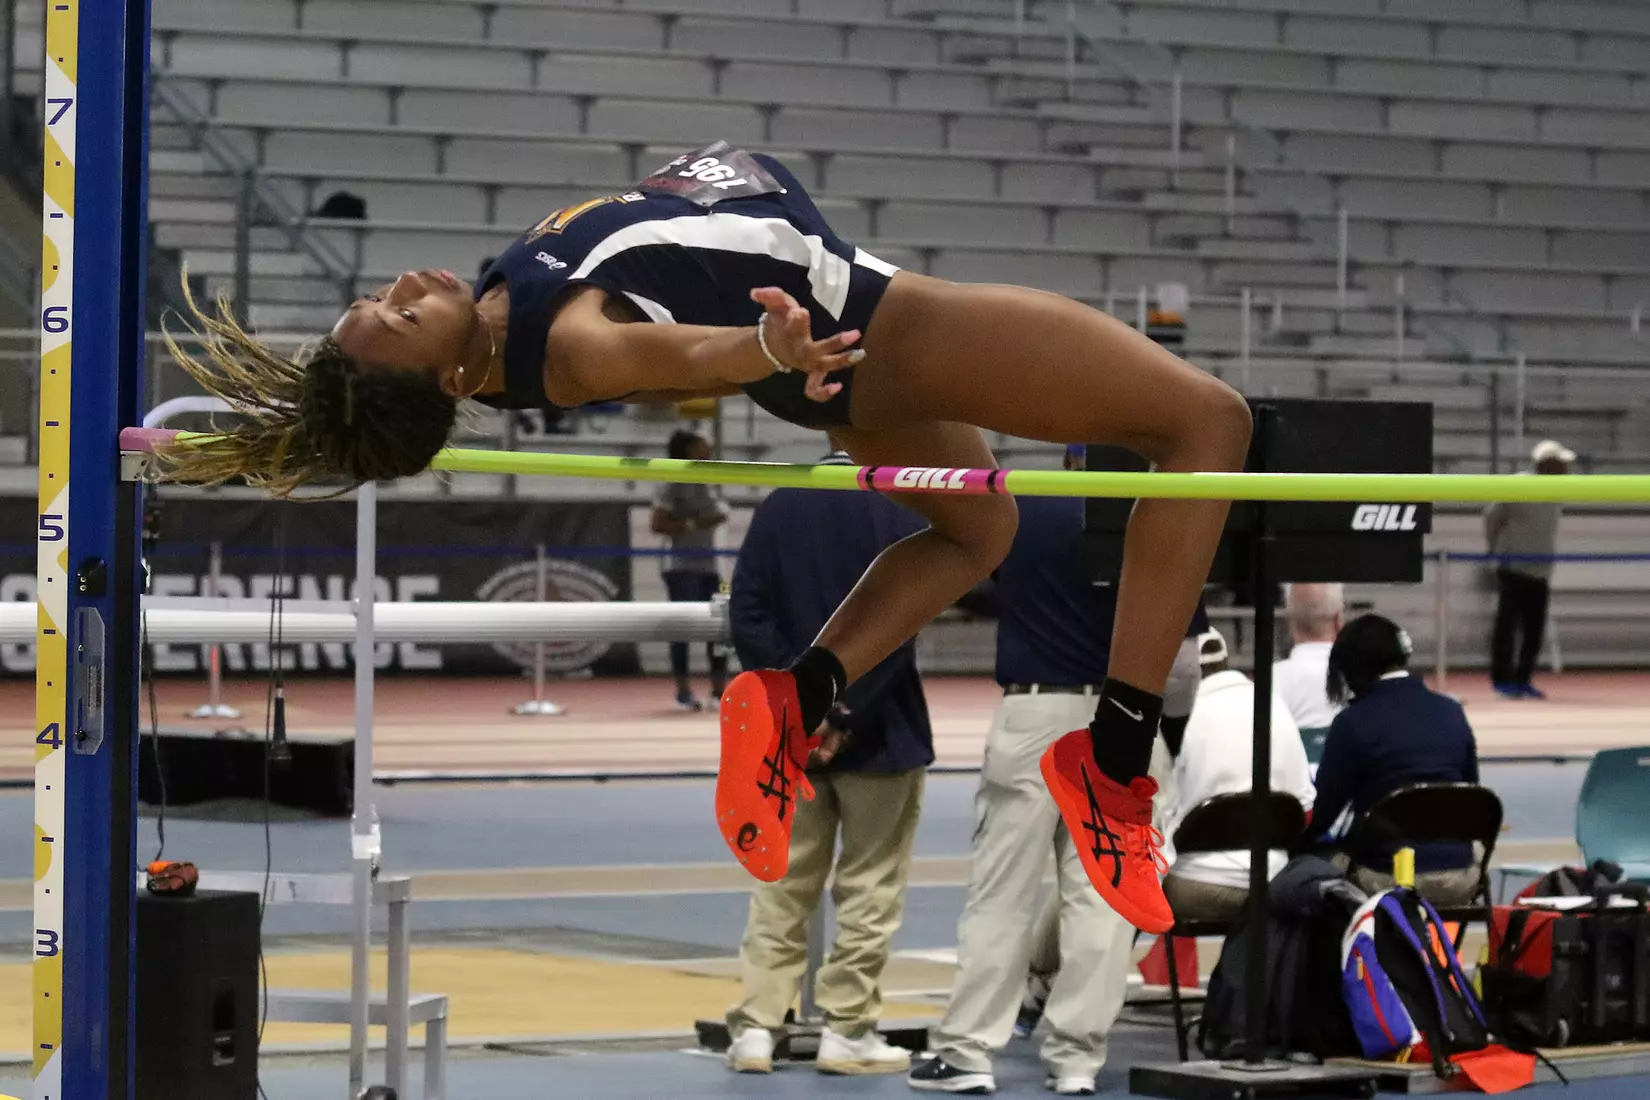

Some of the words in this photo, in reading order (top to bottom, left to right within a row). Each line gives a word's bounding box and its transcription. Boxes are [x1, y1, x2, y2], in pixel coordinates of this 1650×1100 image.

[47, 98, 74, 126] 7
[678, 157, 748, 190] 195
[42, 306, 69, 334] 6
[893, 466, 972, 490] GILL
[39, 514, 65, 542] 5
[1350, 504, 1418, 532] GILL
[36, 722, 63, 750] 4
[36, 929, 59, 957] 3
